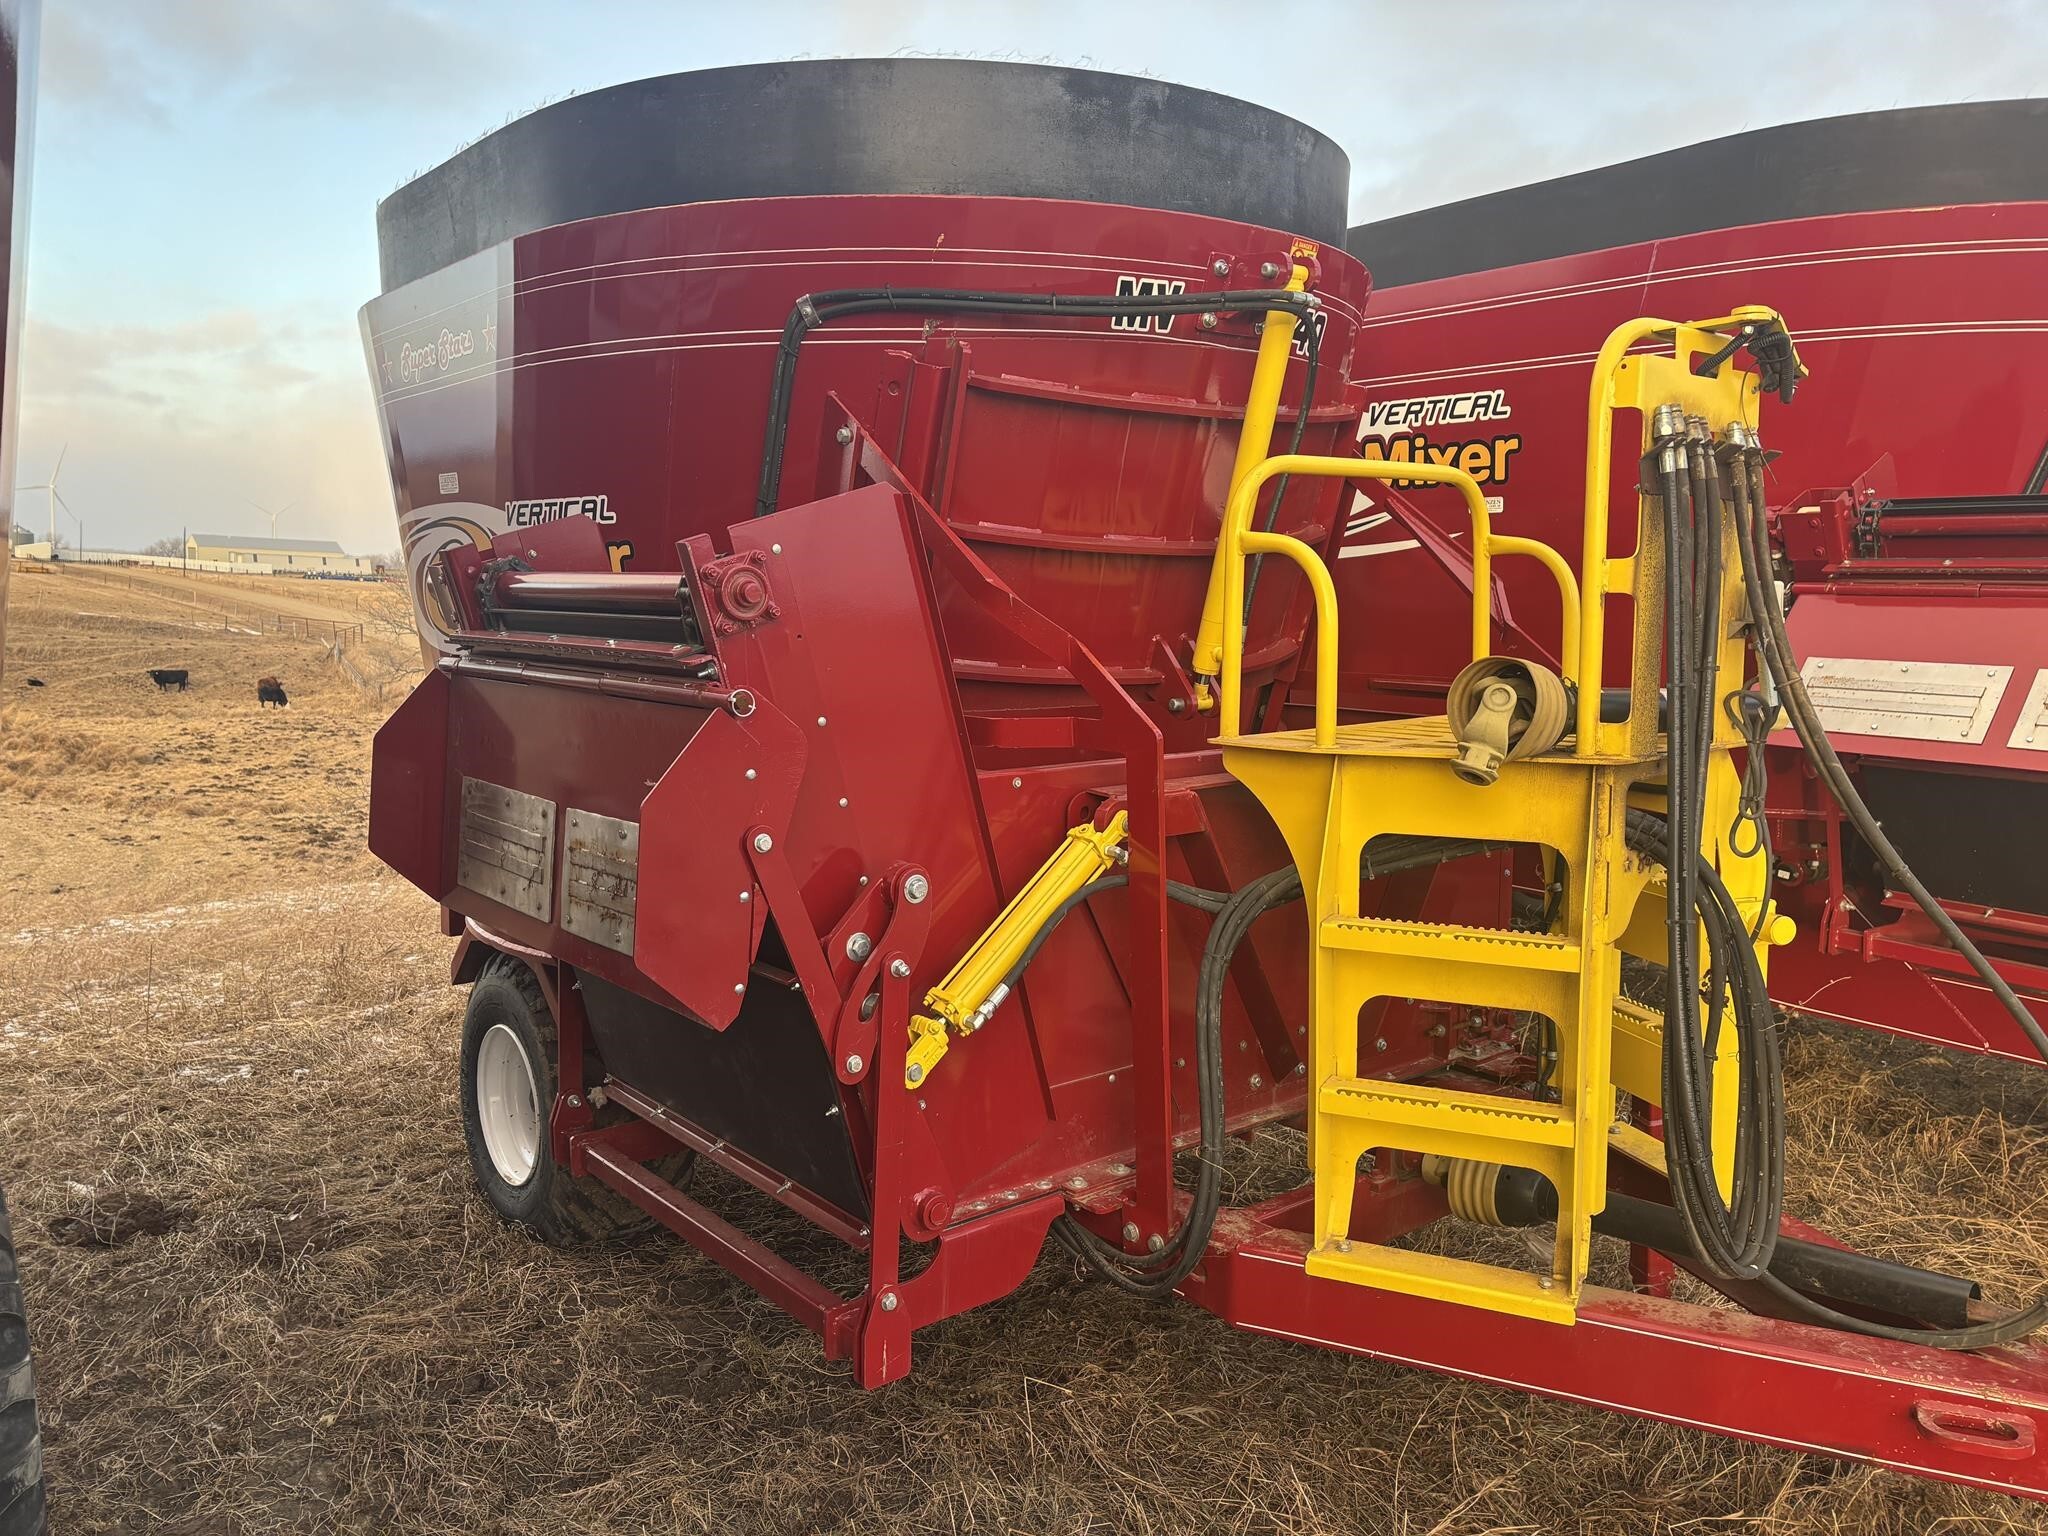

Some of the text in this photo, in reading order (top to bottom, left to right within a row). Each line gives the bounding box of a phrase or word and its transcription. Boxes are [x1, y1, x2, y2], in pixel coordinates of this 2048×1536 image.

[1111, 276, 1185, 333] MV
[401, 328, 474, 383] Super Stars
[1368, 391, 1511, 428] VERTICAL
[1364, 433, 1522, 489] Mixer
[505, 496, 615, 527] VERTICAL
